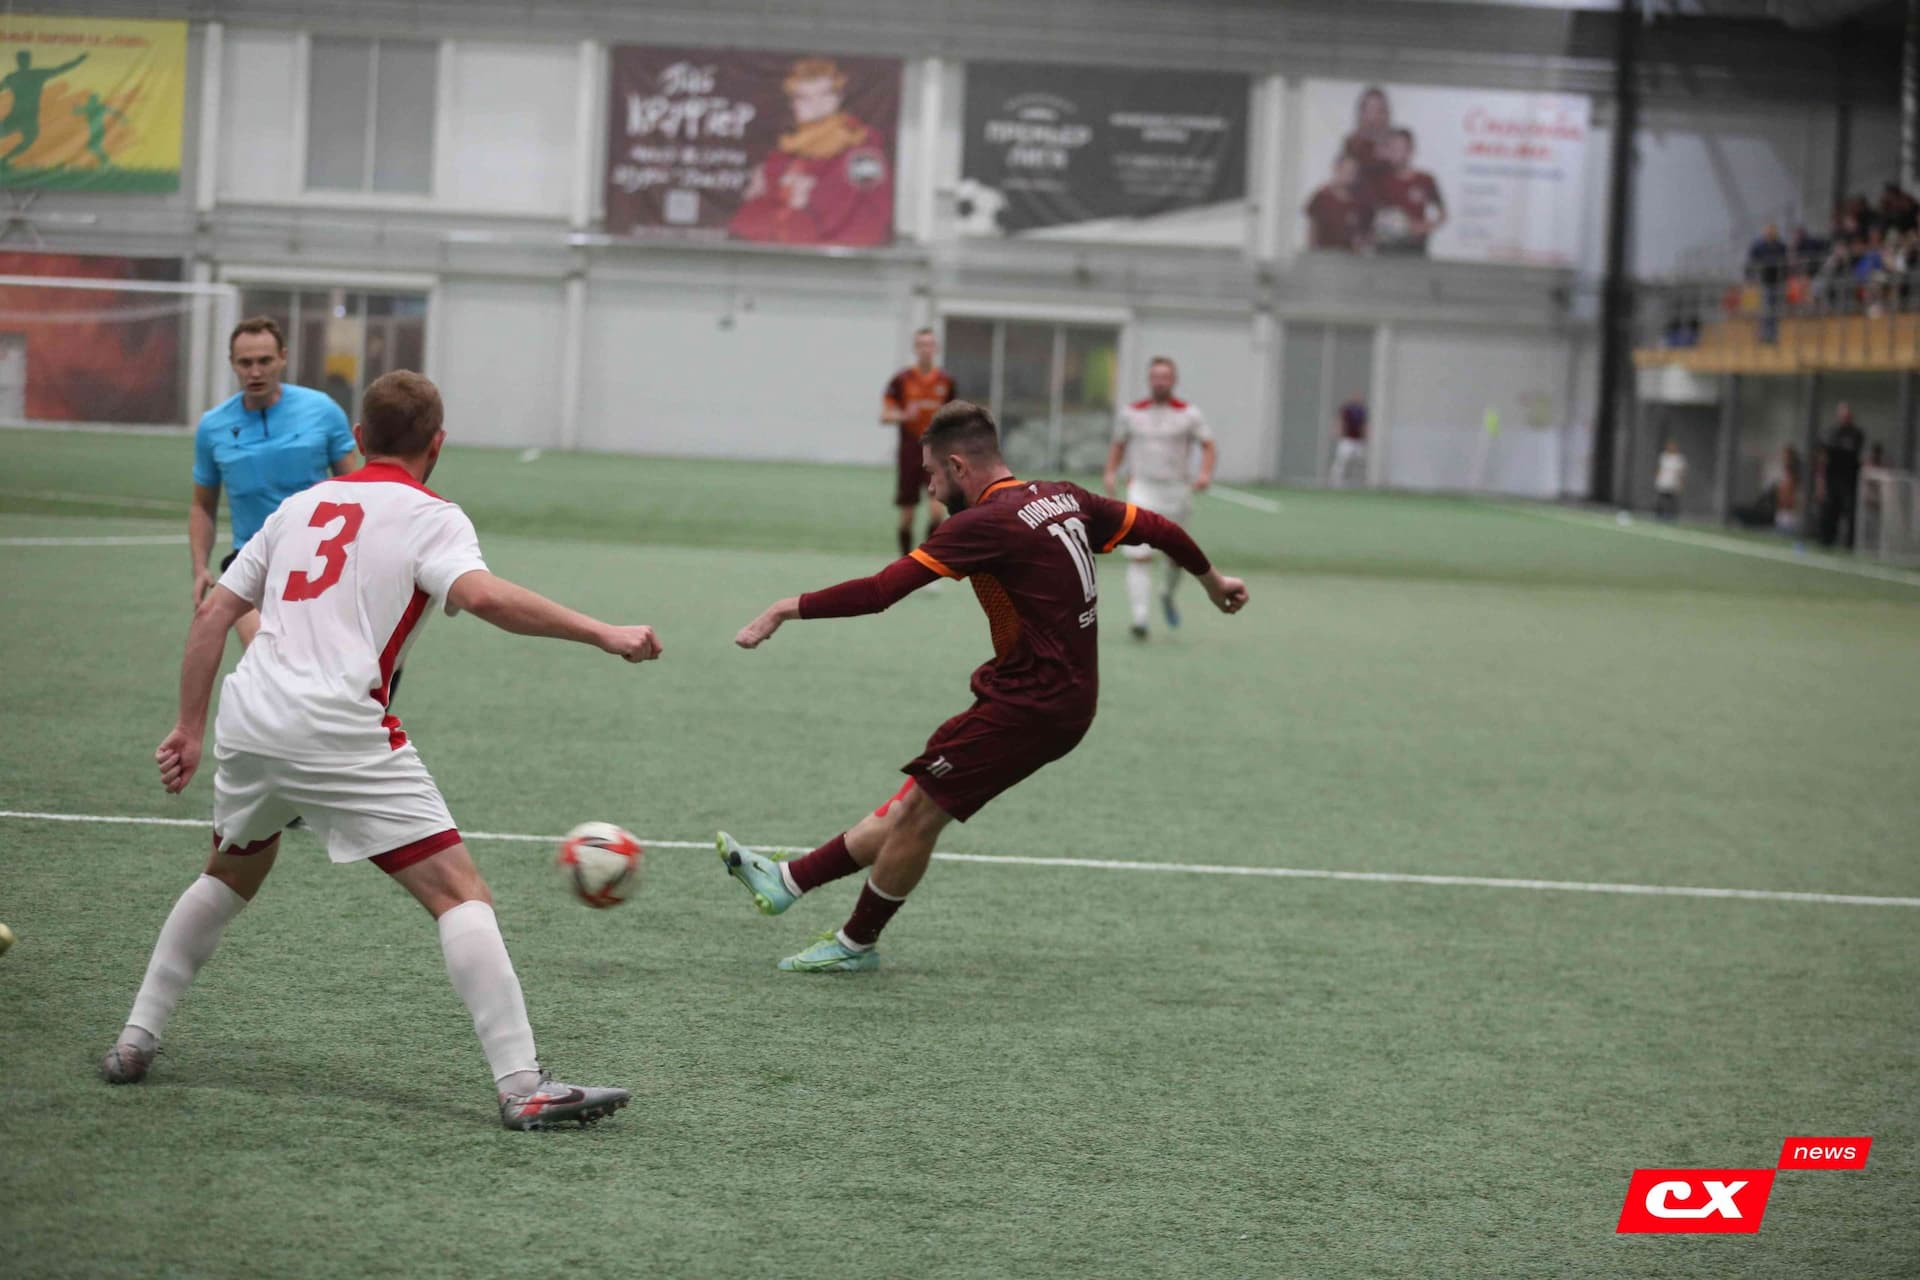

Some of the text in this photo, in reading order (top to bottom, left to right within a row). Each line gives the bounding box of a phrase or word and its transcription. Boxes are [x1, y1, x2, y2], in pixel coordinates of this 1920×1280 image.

[282, 501, 365, 602] 3
[1047, 517, 1096, 603] 10
[926, 755, 953, 778] 10
